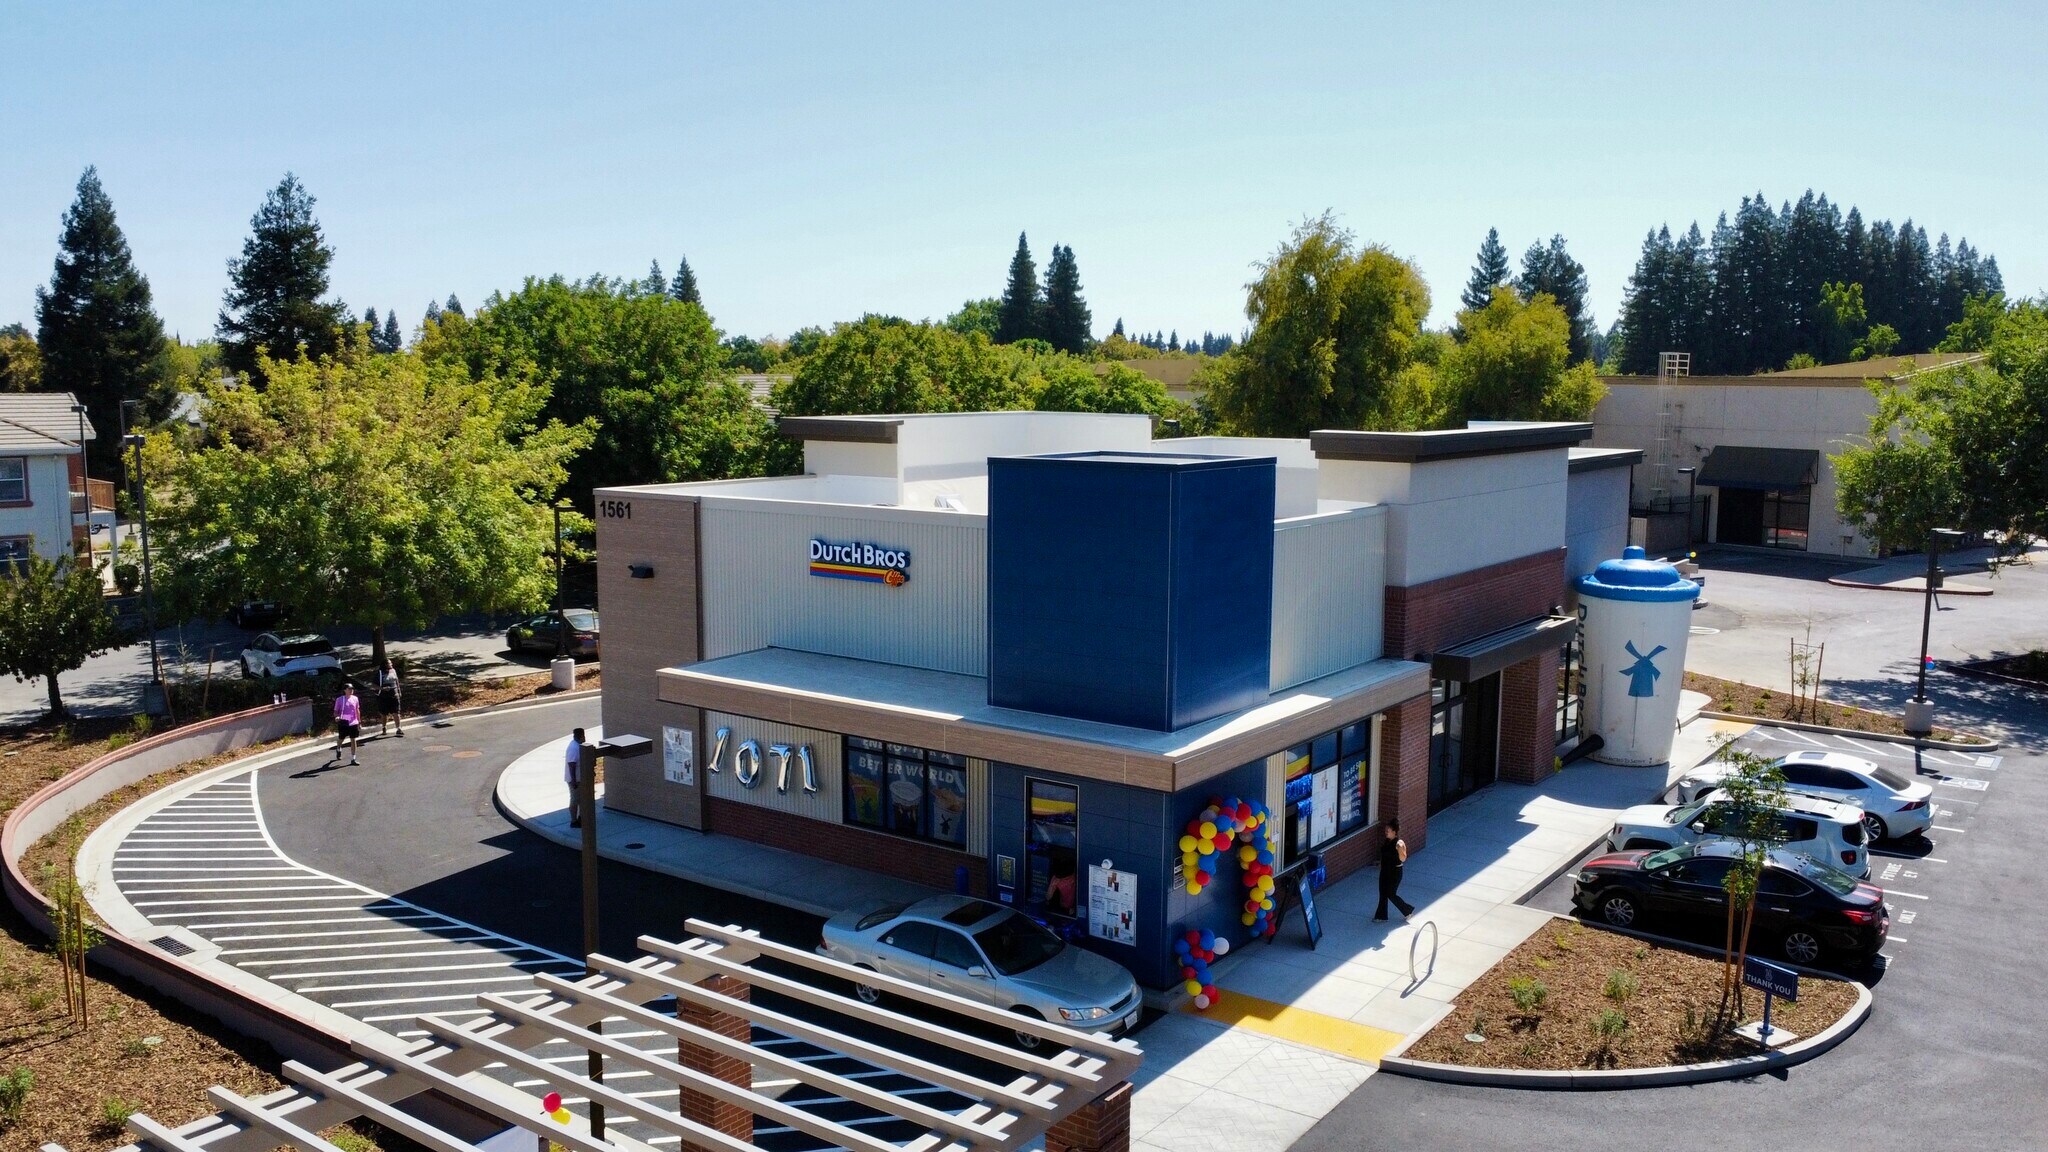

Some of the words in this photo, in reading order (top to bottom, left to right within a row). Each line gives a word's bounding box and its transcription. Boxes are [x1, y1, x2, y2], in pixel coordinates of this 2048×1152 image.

[600, 500, 631, 520] 1561
[810, 539, 861, 564] DUTCH
[864, 544, 906, 568] BROS
[859, 756, 902, 775] BETER
[1746, 973, 1773, 989] THANK
[1774, 983, 1791, 996] YOU
